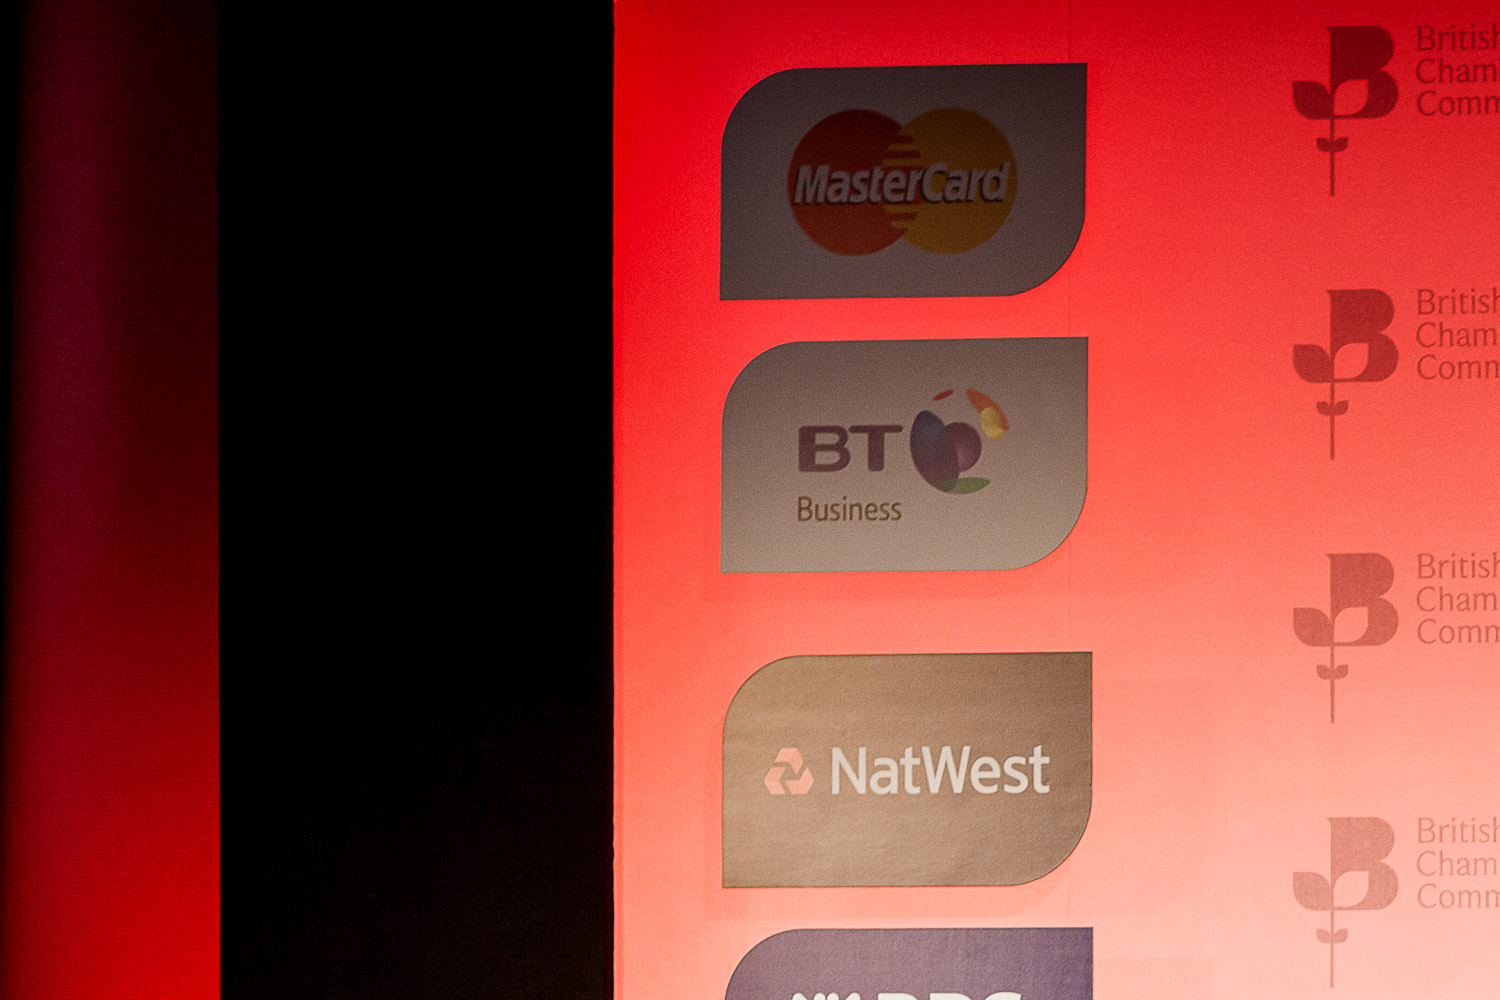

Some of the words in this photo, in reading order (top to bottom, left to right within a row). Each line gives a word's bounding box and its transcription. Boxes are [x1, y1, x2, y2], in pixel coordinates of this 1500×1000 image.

[794, 162, 1011, 206] MasterCard
[798, 425, 903, 473] BT
[797, 496, 902, 522] Business
[831, 745, 1051, 795] NatWest
